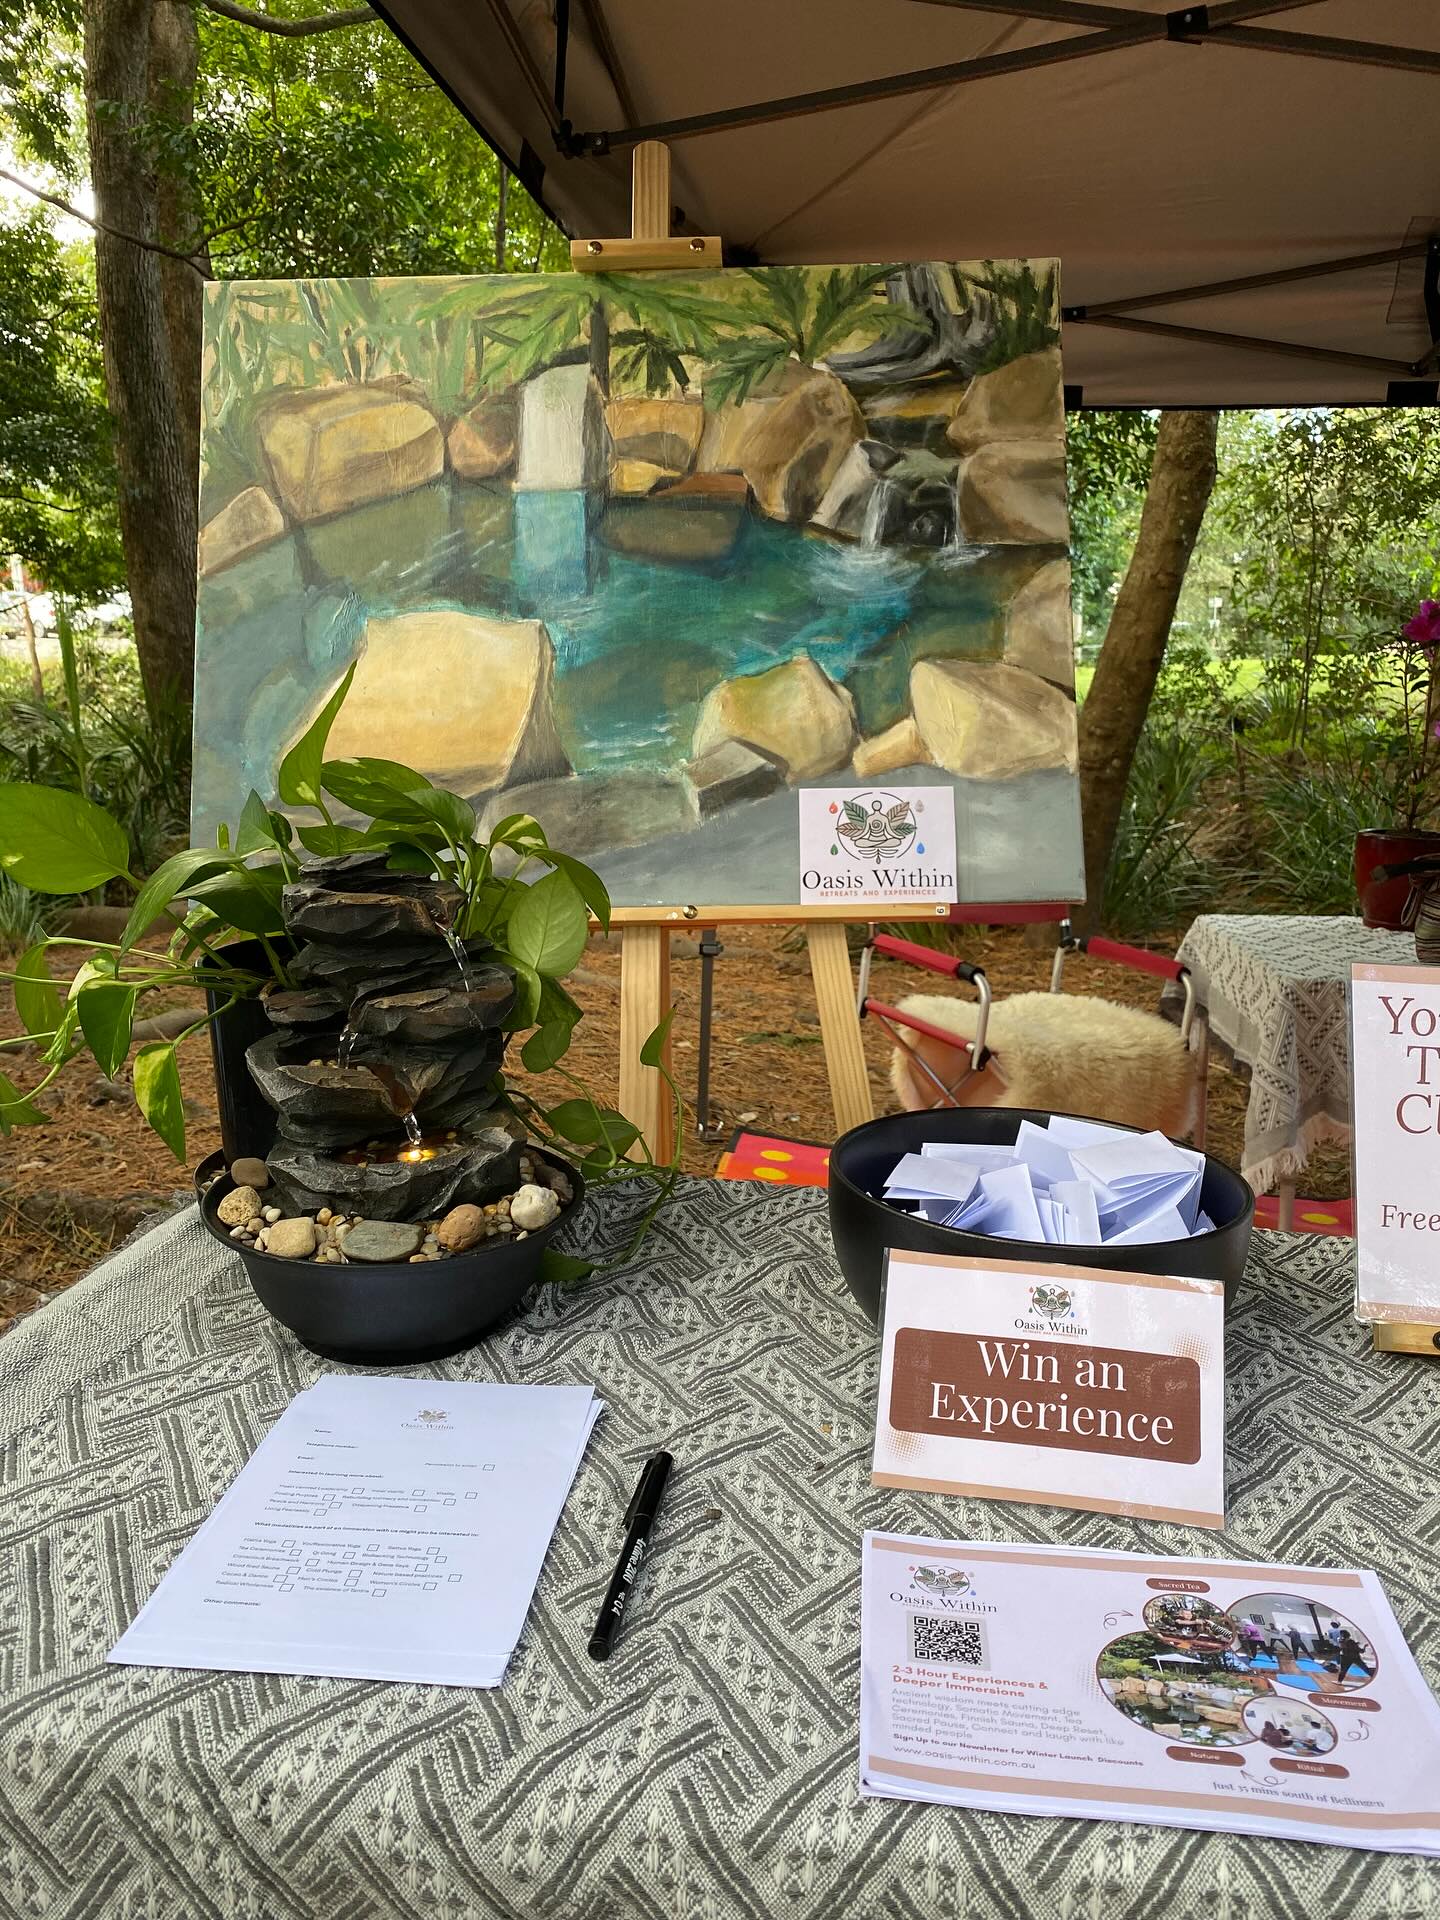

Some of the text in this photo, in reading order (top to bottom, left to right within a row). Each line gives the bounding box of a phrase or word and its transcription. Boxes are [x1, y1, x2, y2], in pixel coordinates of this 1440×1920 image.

[802, 868, 954, 889] Oasis Within
[1378, 996, 1440, 1037] Yo
[1396, 1093, 1440, 1136] C
[1381, 1204, 1440, 1232] Free
[1014, 1318, 1044, 1331] Oasis
[1048, 1321, 1088, 1335] Within
[976, 1339, 1127, 1392] Win an
[928, 1382, 1175, 1446] Experience
[622, 1562, 637, 1585] 200
[1158, 1581, 1185, 1589] Sacred
[890, 1592, 934, 1606] Oasis
[939, 1598, 998, 1613] Within
[892, 1664, 1048, 1690] 2-3 Hour Experiences &
[893, 1675, 1025, 1698] Deeper Immersions
[892, 1688, 1081, 1717] Ancient wisdom meets cutting edge
[956, 1704, 999, 1716] Somatic
[1320, 1697, 1367, 1708] Movement
[892, 1713, 930, 1725] Sacred
[971, 1723, 1018, 1735] Connect
[1021, 1729, 1042, 1738] and
[1045, 1731, 1077, 1742] laugh
[1080, 1735, 1103, 1744] with
[1105, 1736, 1124, 1746] like
[892, 1723, 973, 1739] minded people
[961, 1713, 997, 1724] Finnish
[1040, 1722, 1070, 1732] Deep
[893, 1733, 914, 1742] Sign
[916, 1736, 929, 1744] Up
[959, 1742, 1009, 1753] Newsletter
[1011, 1747, 1025, 1755] for
[1026, 1749, 1057, 1758] Winter
[1059, 1753, 1093, 1762] Launch
[1097, 1756, 1144, 1767] Discounts
[893, 1745, 1036, 1770] www.oasis-within.com.au
[1189, 1752, 1220, 1761] Nature
[1212, 1781, 1234, 1791] Just
[1251, 1786, 1280, 1797] mins
[1282, 1790, 1314, 1801] south
[1316, 1794, 1329, 1803] of
[1330, 1795, 1385, 1808] Bellingen
